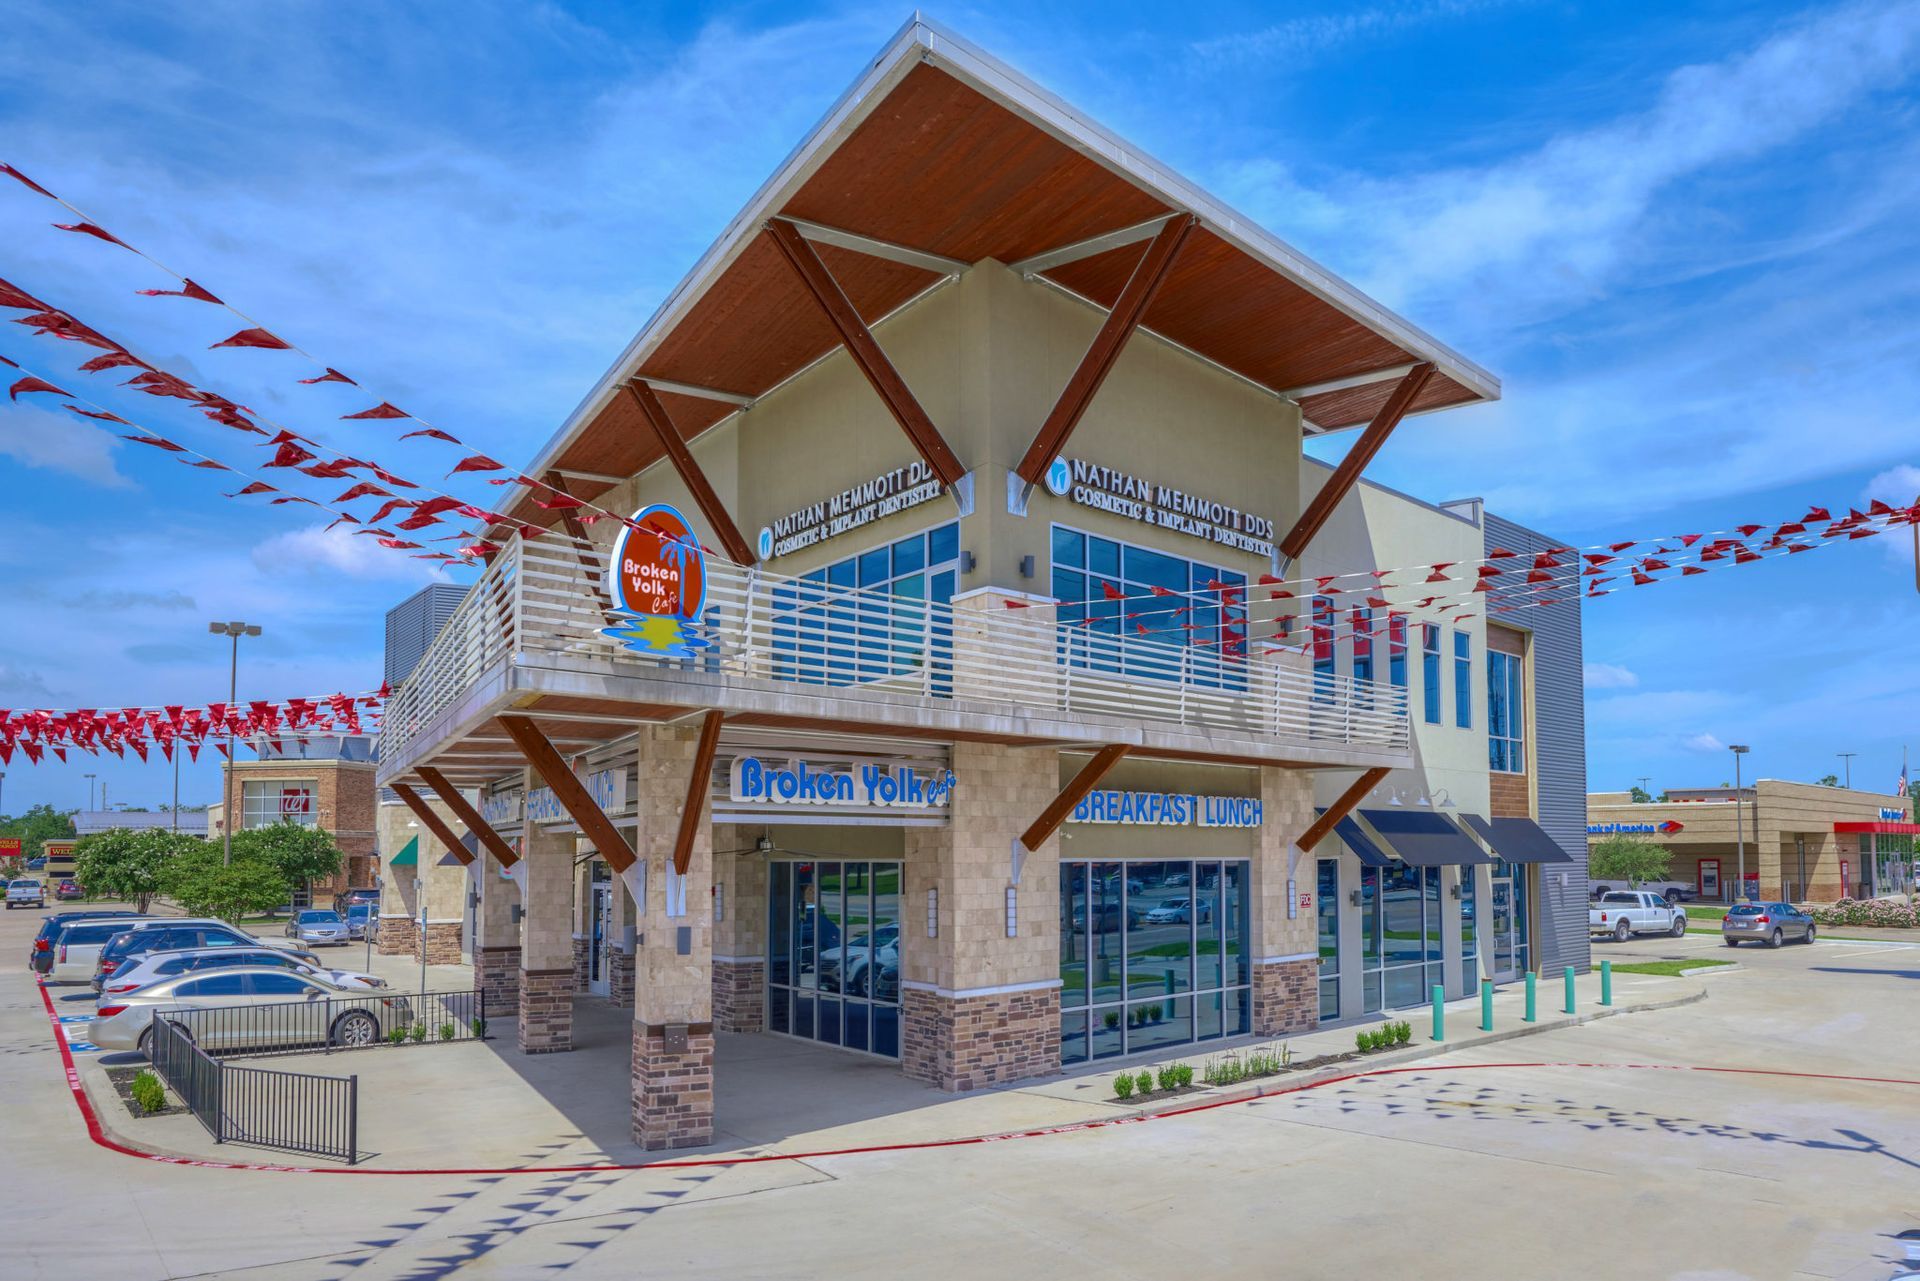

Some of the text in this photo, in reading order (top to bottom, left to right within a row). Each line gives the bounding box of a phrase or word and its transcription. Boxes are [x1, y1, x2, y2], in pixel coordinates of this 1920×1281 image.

[774, 459, 935, 539] NATHAN MEMMOTT DD
[774, 479, 941, 556] COSMETIC & IMPLANT DENTISTRY
[1073, 457, 1274, 540] NATHAN MEMMOTT DDS
[1073, 485, 1274, 557] COSMETIC & IMPLANT DENTISTRY
[624, 558, 679, 582] Broken
[632, 576, 666, 596] Yolk
[741, 757, 854, 801] Broken
[862, 764, 923, 803] Yolk
[1074, 791, 1263, 826] BREAKFAST LUNCH
[1587, 823, 1603, 833] ank
